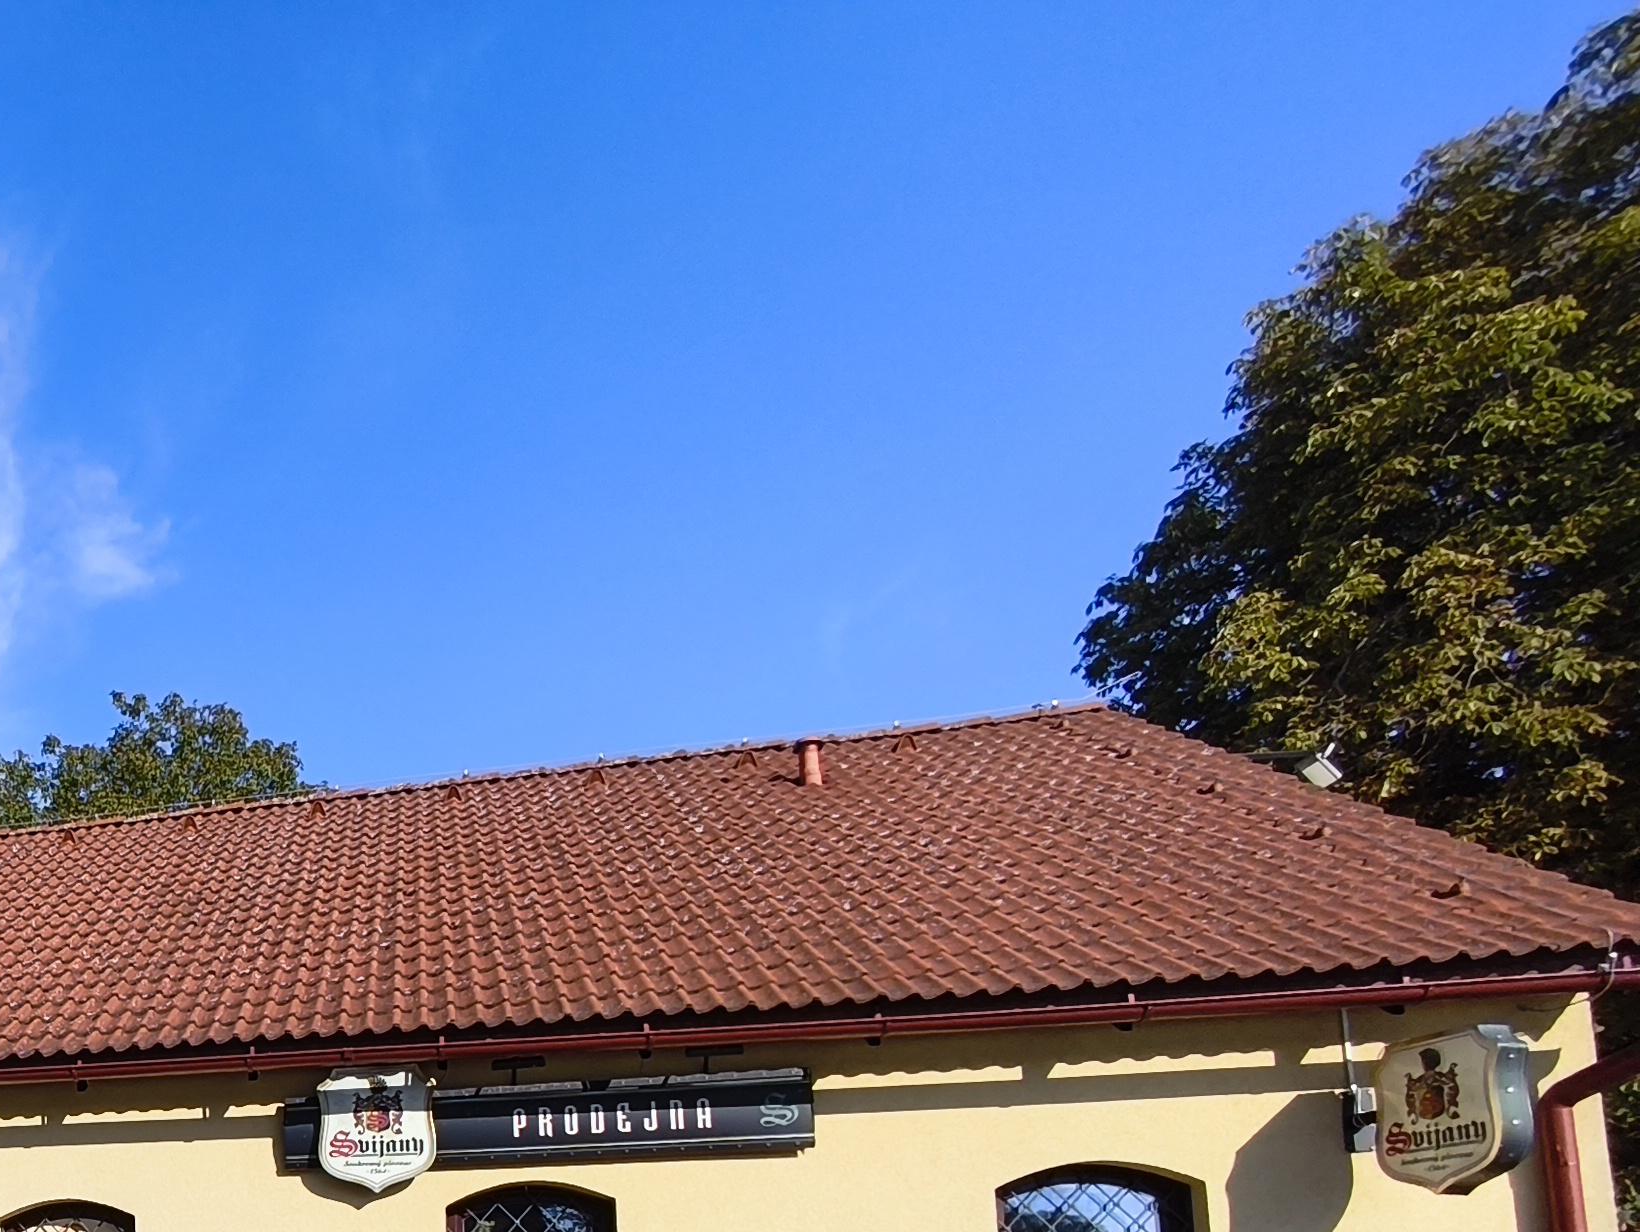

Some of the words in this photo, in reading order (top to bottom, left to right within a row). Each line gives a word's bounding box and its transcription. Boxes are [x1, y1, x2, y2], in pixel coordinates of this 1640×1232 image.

[512, 1097, 712, 1138] PRODEJNA
[759, 1092, 800, 1127] S
[329, 1130, 424, 1158] Svijany
[1385, 1120, 1487, 1157] Svijany
